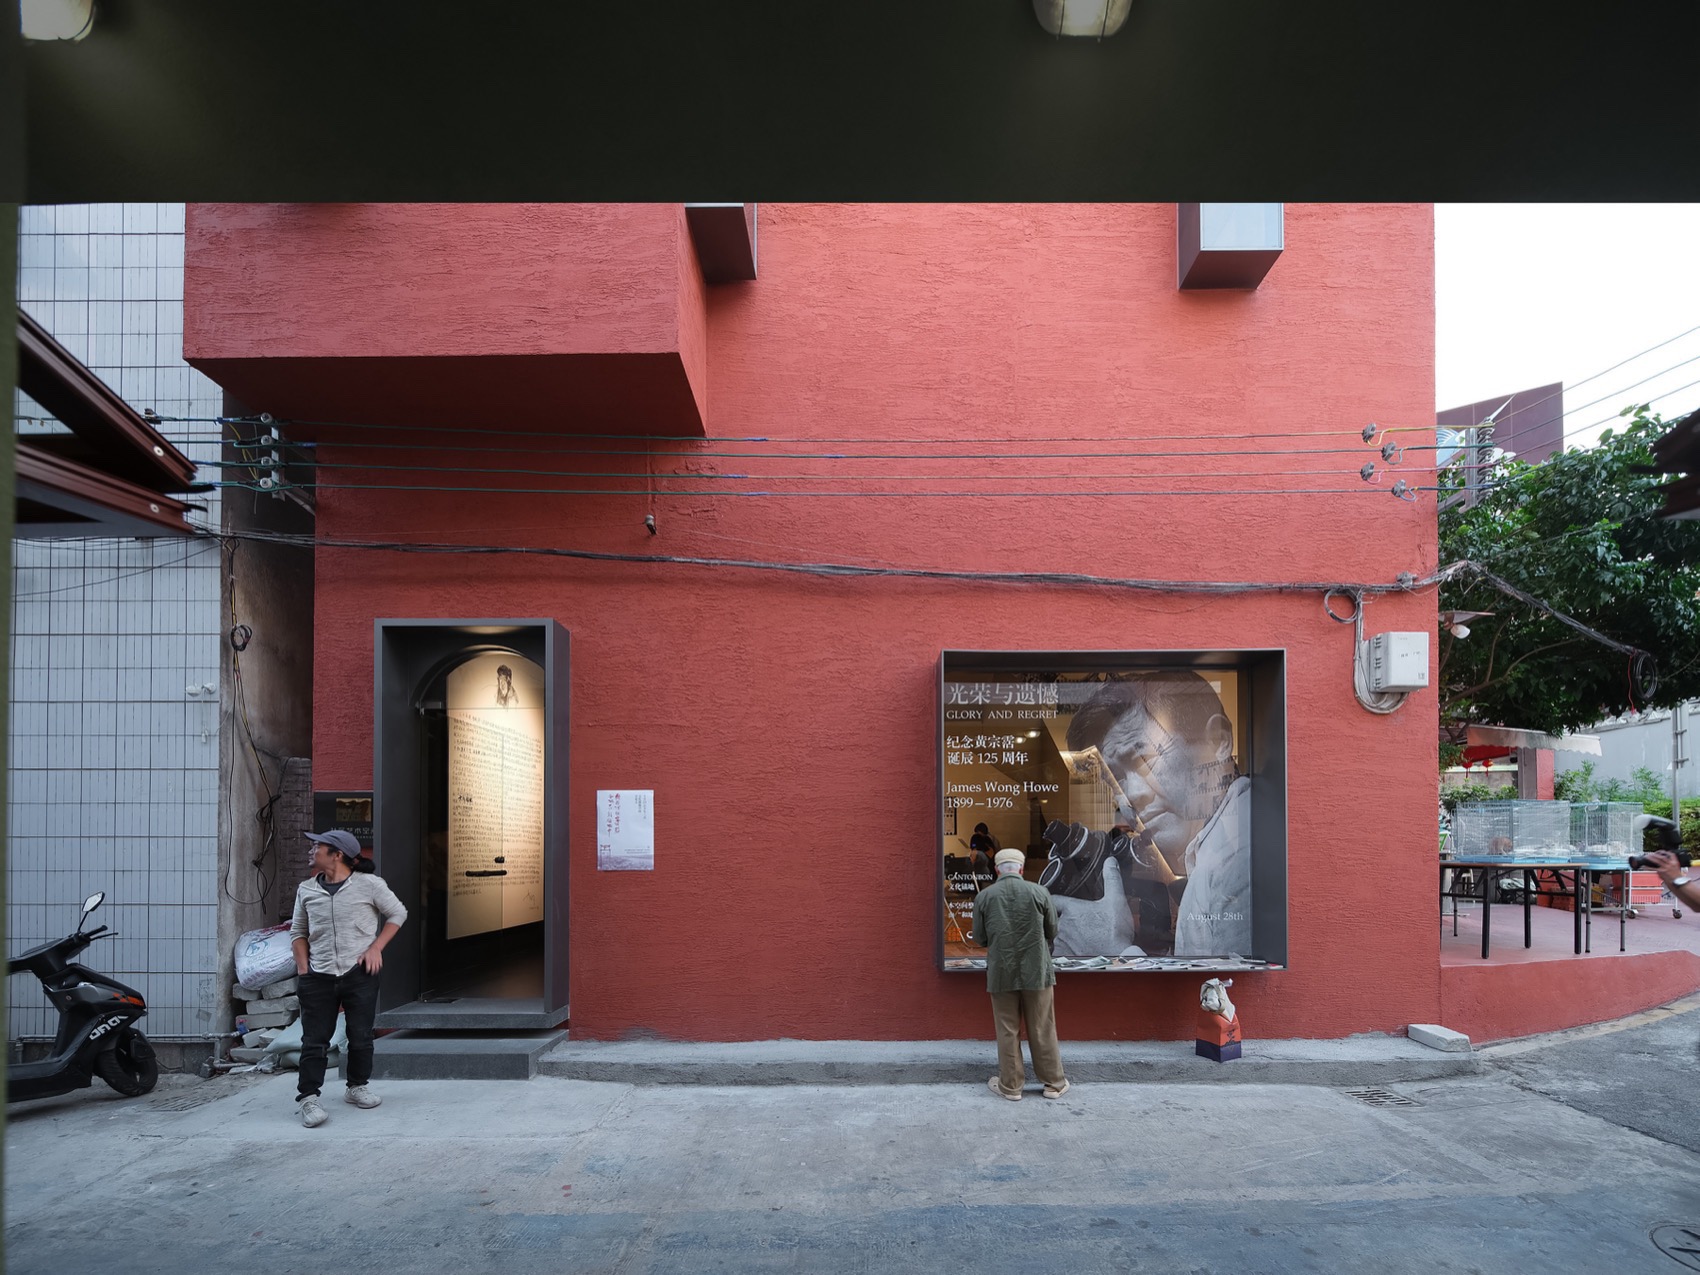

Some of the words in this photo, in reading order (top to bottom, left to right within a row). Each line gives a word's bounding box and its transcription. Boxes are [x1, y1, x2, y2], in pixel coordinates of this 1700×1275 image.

[947, 683, 1059, 705] 光荣与遗憾
[946, 710, 982, 719] GLORY
[988, 710, 1012, 719] AND
[1017, 710, 1058, 719] REGRET
[947, 751, 973, 765] 诞辰
[977, 753, 998, 764] 125
[1001, 751, 1028, 765] 周年
[946, 781, 981, 794] James
[984, 781, 1020, 796] Wong
[1023, 781, 1059, 792] Howe
[1186, 912, 1221, 923] August
[1223, 912, 1244, 921] 28th
